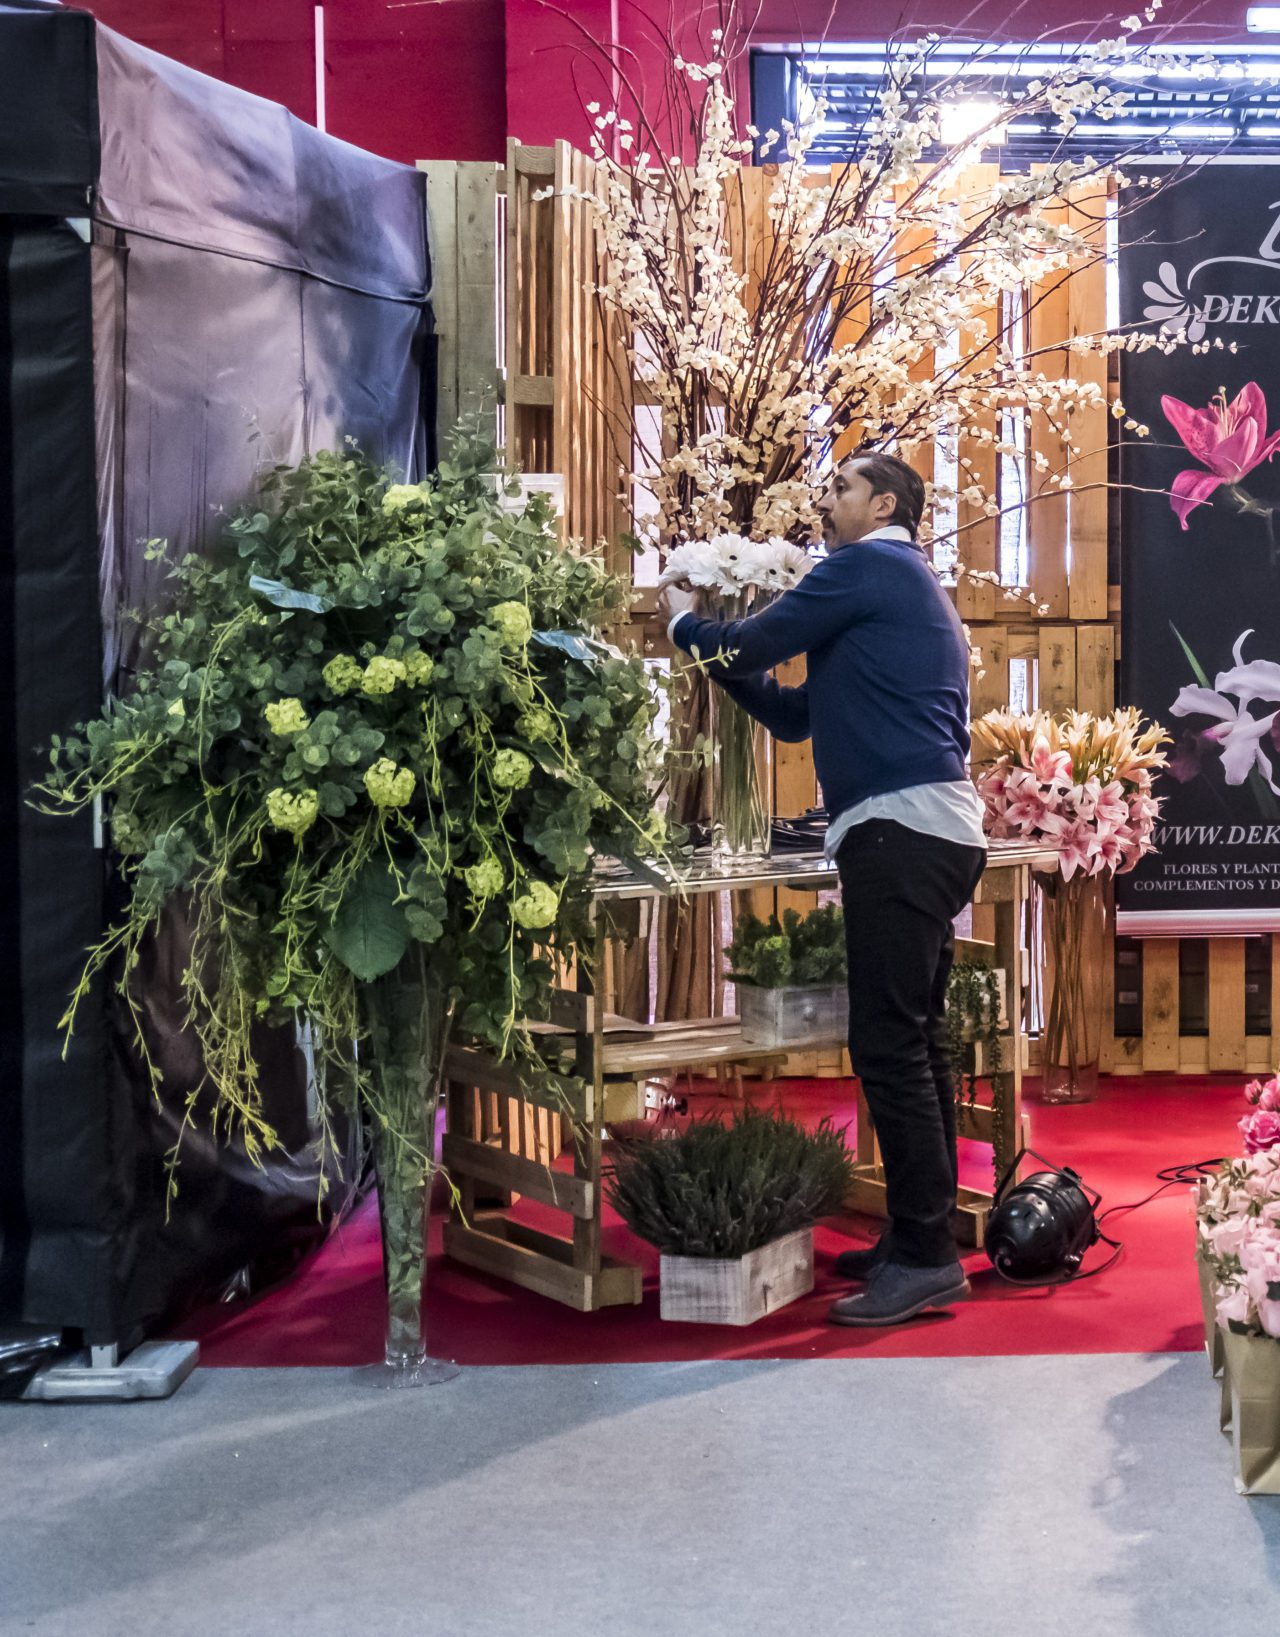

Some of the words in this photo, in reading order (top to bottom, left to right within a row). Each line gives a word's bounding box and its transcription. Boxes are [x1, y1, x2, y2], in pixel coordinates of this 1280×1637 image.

[1163, 863, 1218, 875] FLORES
[1221, 863, 1232, 874] Y
[1133, 879, 1255, 892] COMPLEMENTOS
[1258, 879, 1268, 890] Y
